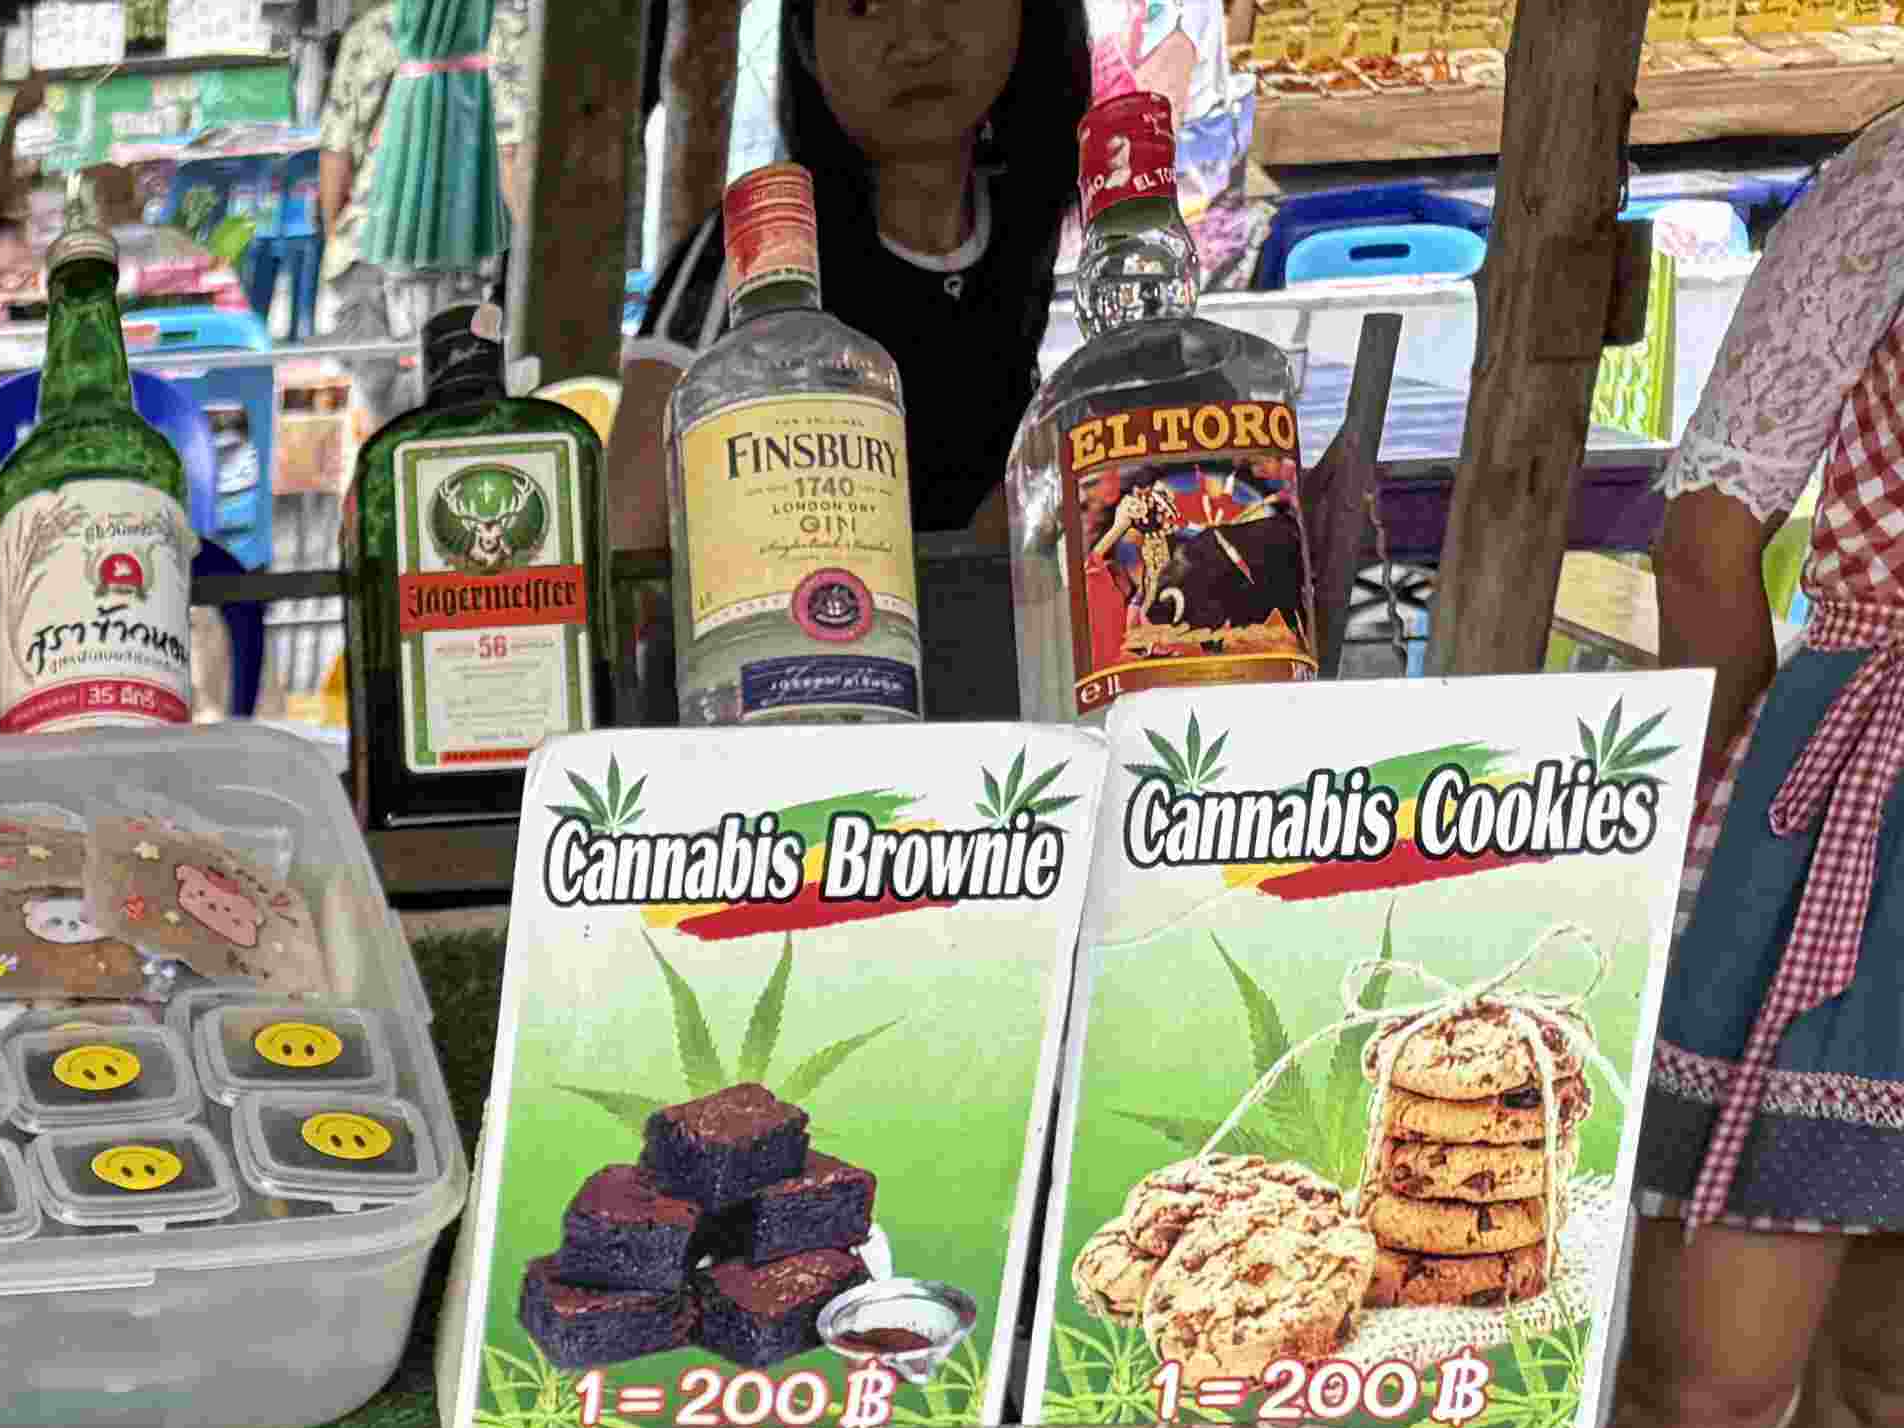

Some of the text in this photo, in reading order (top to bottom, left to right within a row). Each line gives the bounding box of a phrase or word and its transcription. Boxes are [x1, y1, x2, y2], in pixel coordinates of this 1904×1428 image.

[726, 431, 899, 480] FINSBURY
[1071, 403, 1295, 471] EL TORO
[772, 502, 842, 515] LONDON
[794, 476, 855, 498] 1740
[799, 515, 857, 535] GIN
[87, 686, 114, 706] 35
[1124, 760, 1660, 868] Cannabis Cookies
[544, 809, 1067, 906] Cannabis Brownie
[575, 1367, 603, 1427] 1
[674, 1366, 830, 1427] 200
[1151, 1358, 1183, 1422] 1
[1256, 1358, 1419, 1421] 200
